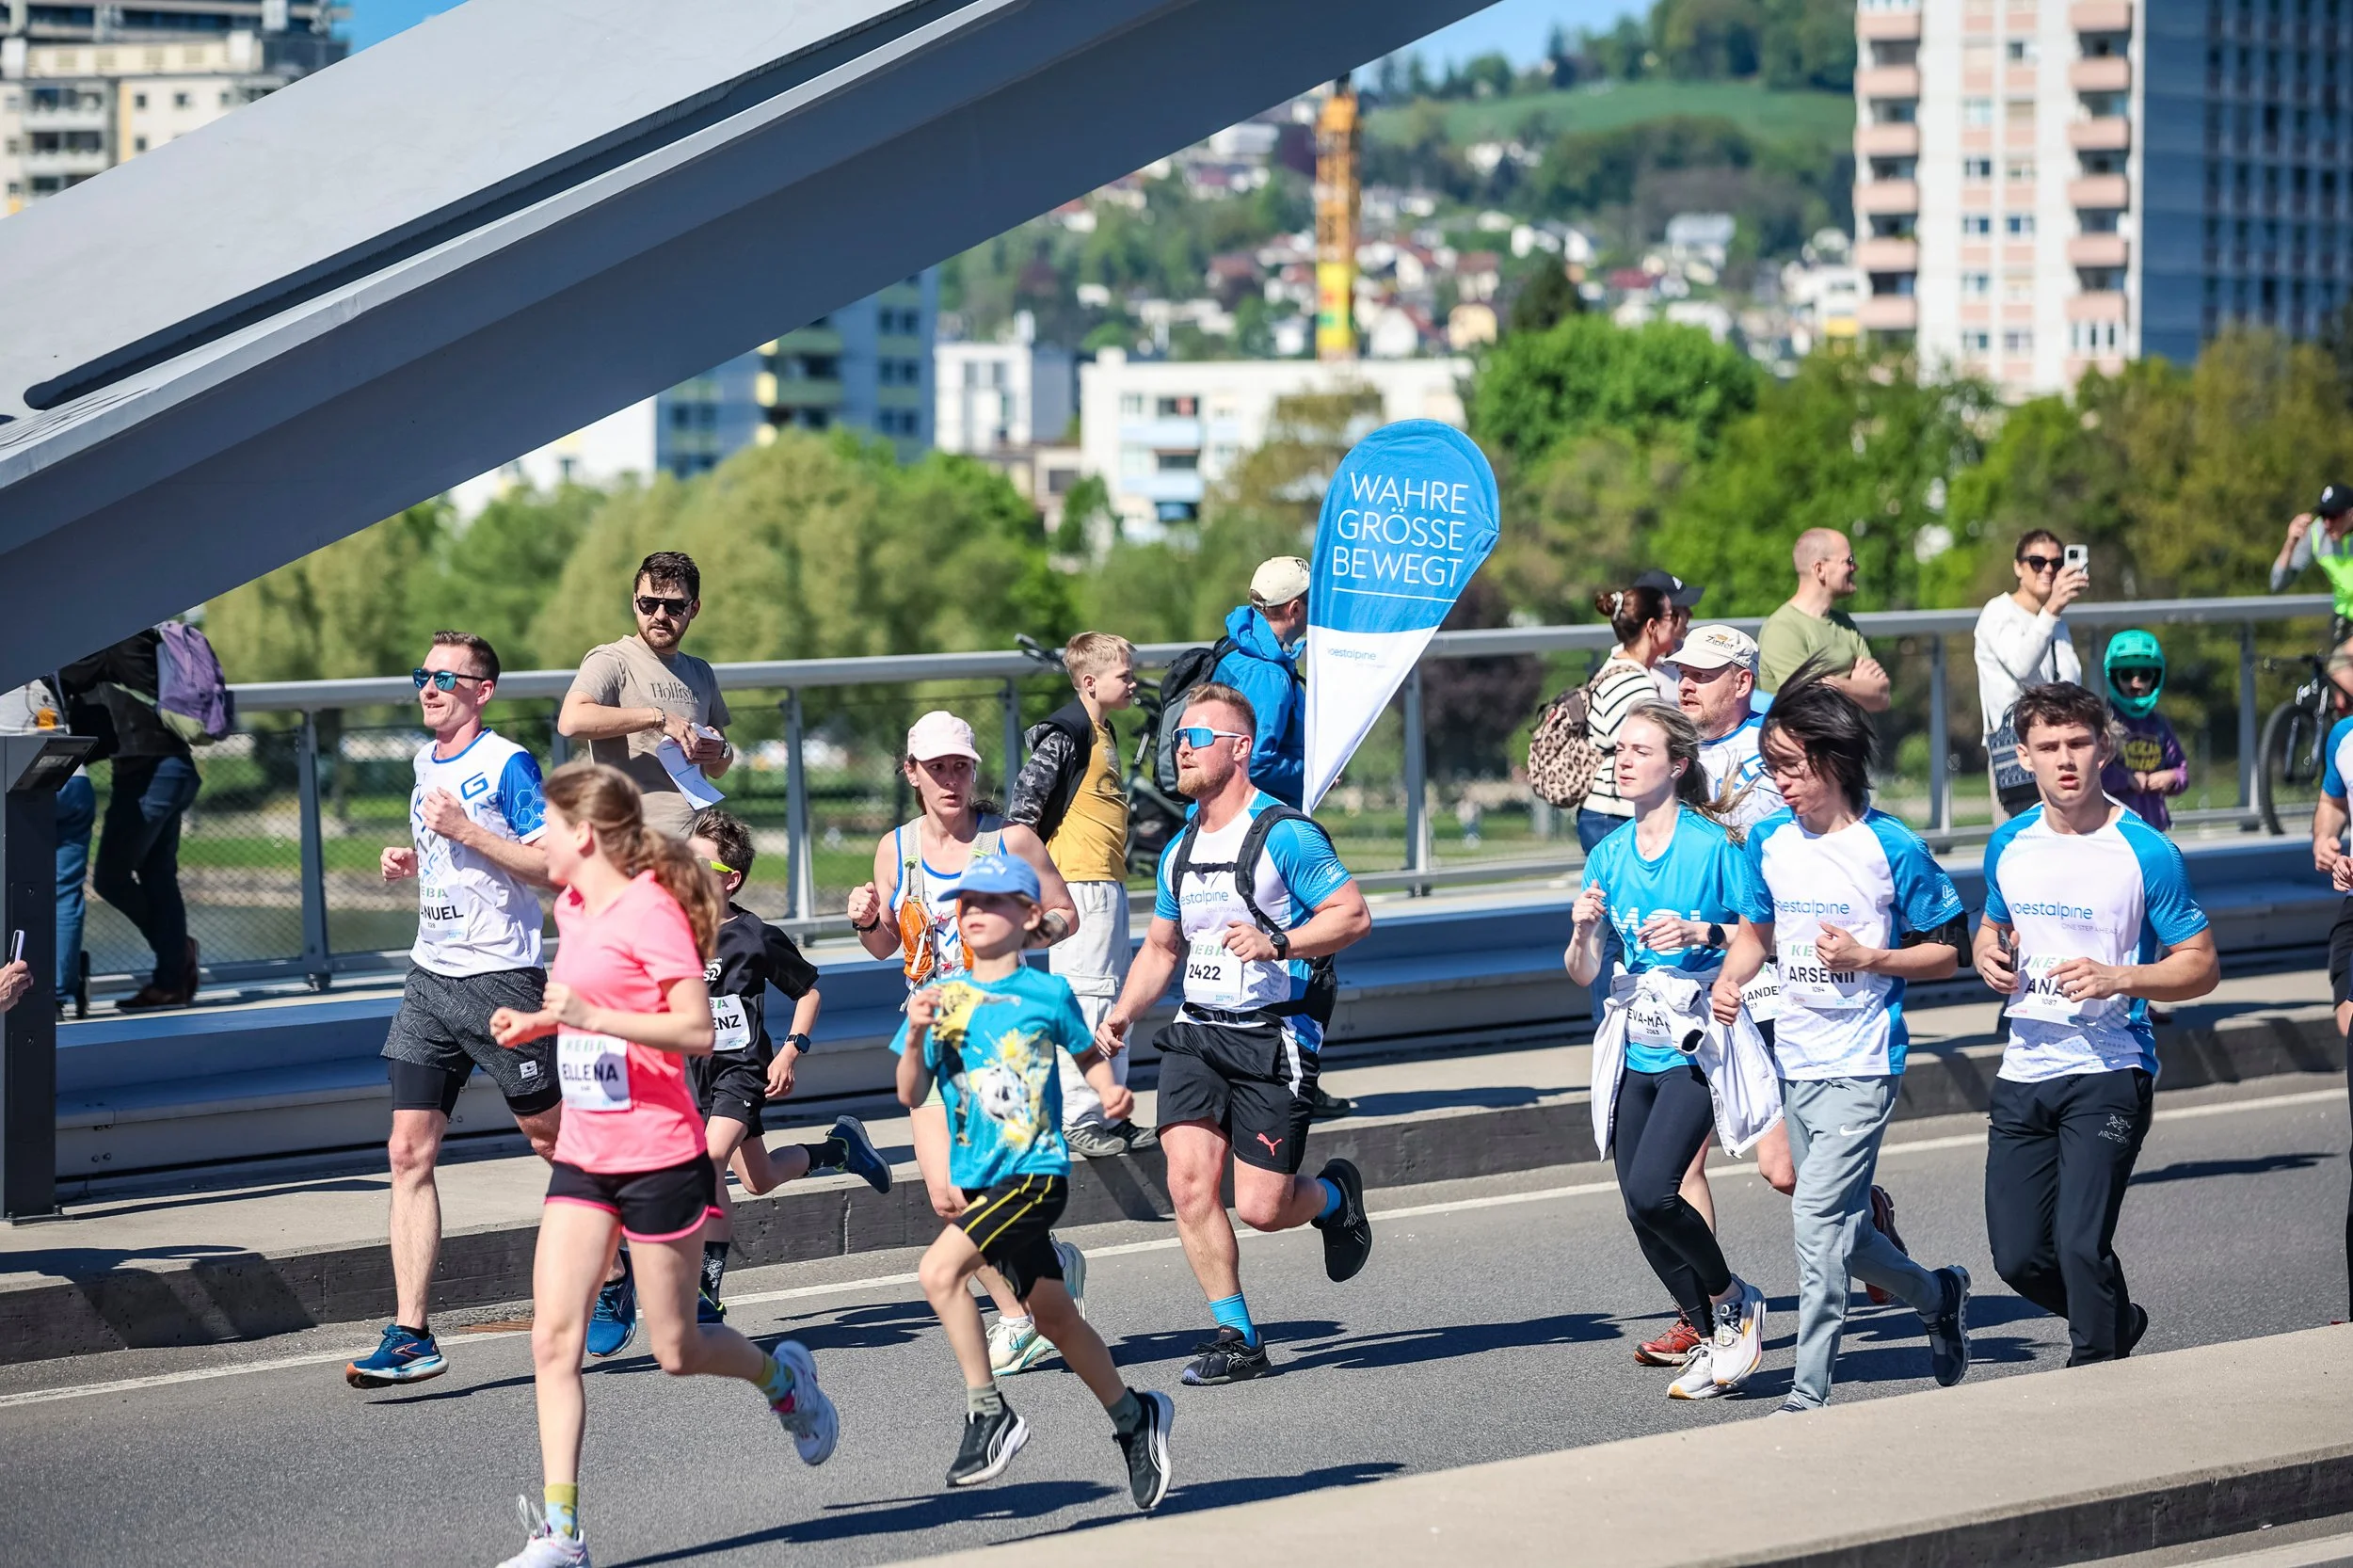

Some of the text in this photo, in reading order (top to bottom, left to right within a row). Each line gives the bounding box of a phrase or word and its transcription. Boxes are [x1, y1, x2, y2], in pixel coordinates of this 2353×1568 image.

[1350, 472, 1468, 515] WAHRE
[1337, 506, 1465, 552] GRÖSSE
[1332, 546, 1464, 587] BEWEGT
[1705, 635, 1734, 650] Zipfer
[421, 904, 464, 920] NUEL
[1189, 963, 1222, 981] 2422
[1789, 966, 1855, 984] ARSENII
[562, 1063, 620, 1081] ELLENA
